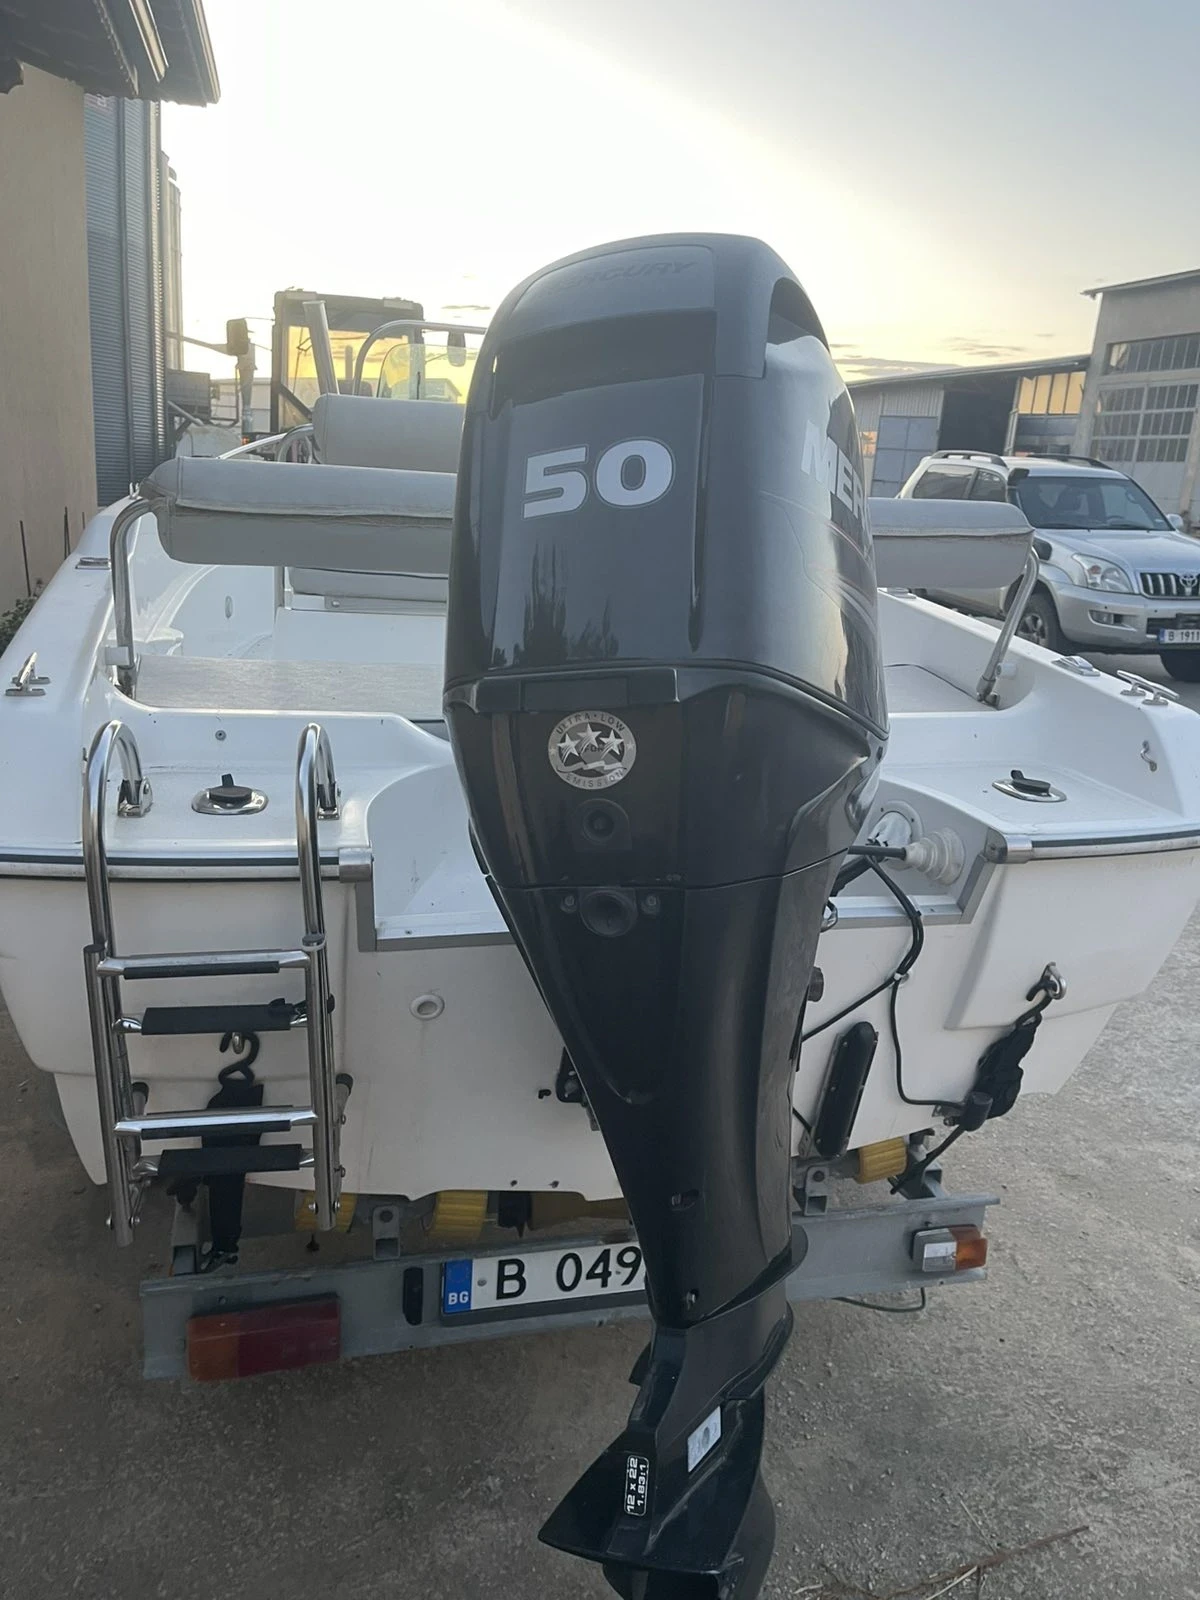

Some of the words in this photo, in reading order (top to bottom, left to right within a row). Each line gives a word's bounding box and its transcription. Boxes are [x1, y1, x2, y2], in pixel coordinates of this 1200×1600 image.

[523, 439, 673, 519] 50
[556, 712, 591, 735] ULTRA
[601, 713, 625, 731] LOW
[566, 768, 625, 789] EMISSION
[496, 1258, 527, 1300] B
[448, 1291, 469, 1305] BG
[629, 1457, 638, 1479] 22
[627, 1494, 636, 1512] 12
